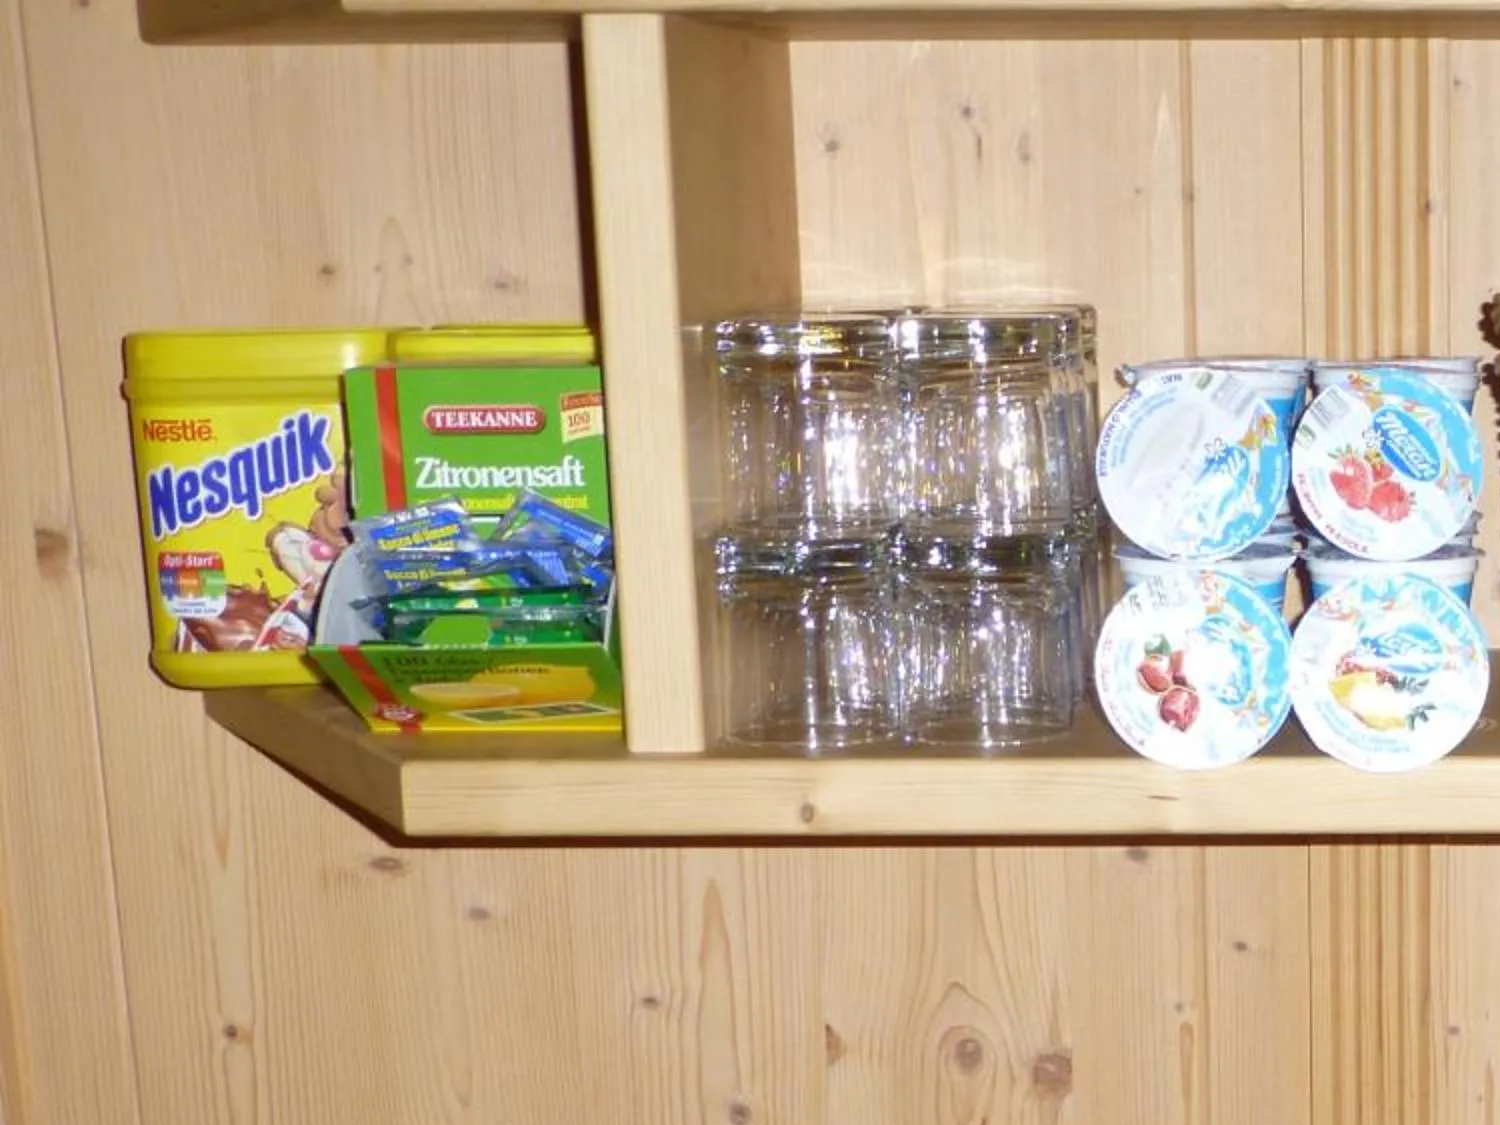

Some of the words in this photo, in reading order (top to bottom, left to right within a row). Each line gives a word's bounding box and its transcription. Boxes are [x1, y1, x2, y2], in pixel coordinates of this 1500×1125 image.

[431, 410, 539, 428] TEEKANNE
[148, 412, 333, 538] Nesquik
[415, 454, 587, 489] Zitronensaft
